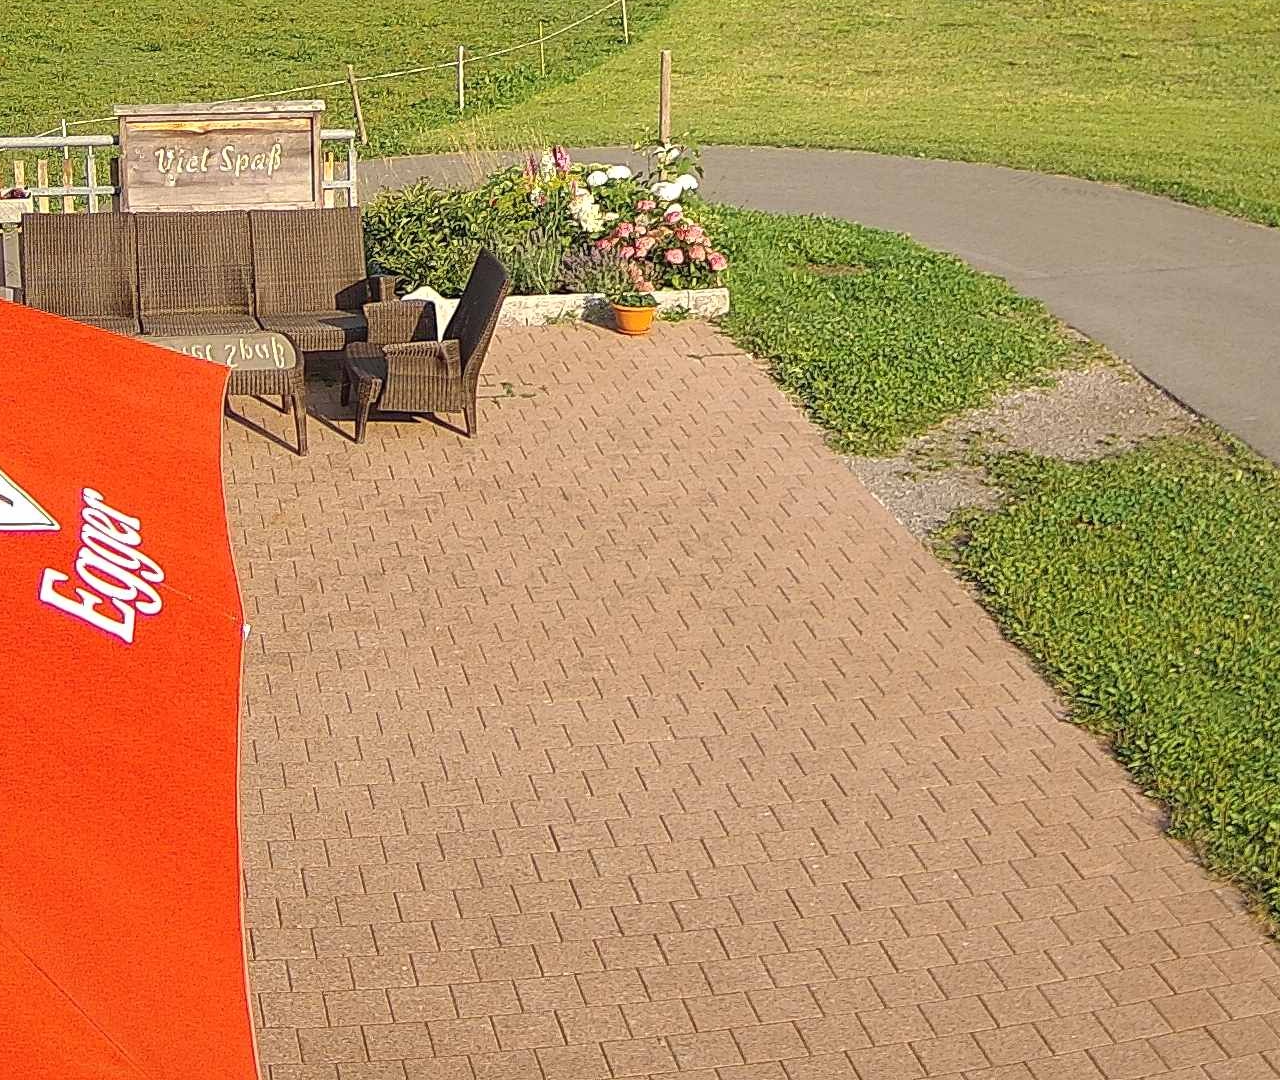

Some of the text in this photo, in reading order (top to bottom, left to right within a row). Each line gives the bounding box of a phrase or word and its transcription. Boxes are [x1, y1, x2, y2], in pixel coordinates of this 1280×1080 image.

[154, 143, 282, 177] Viel Spaß
[39, 487, 166, 644] Egger
